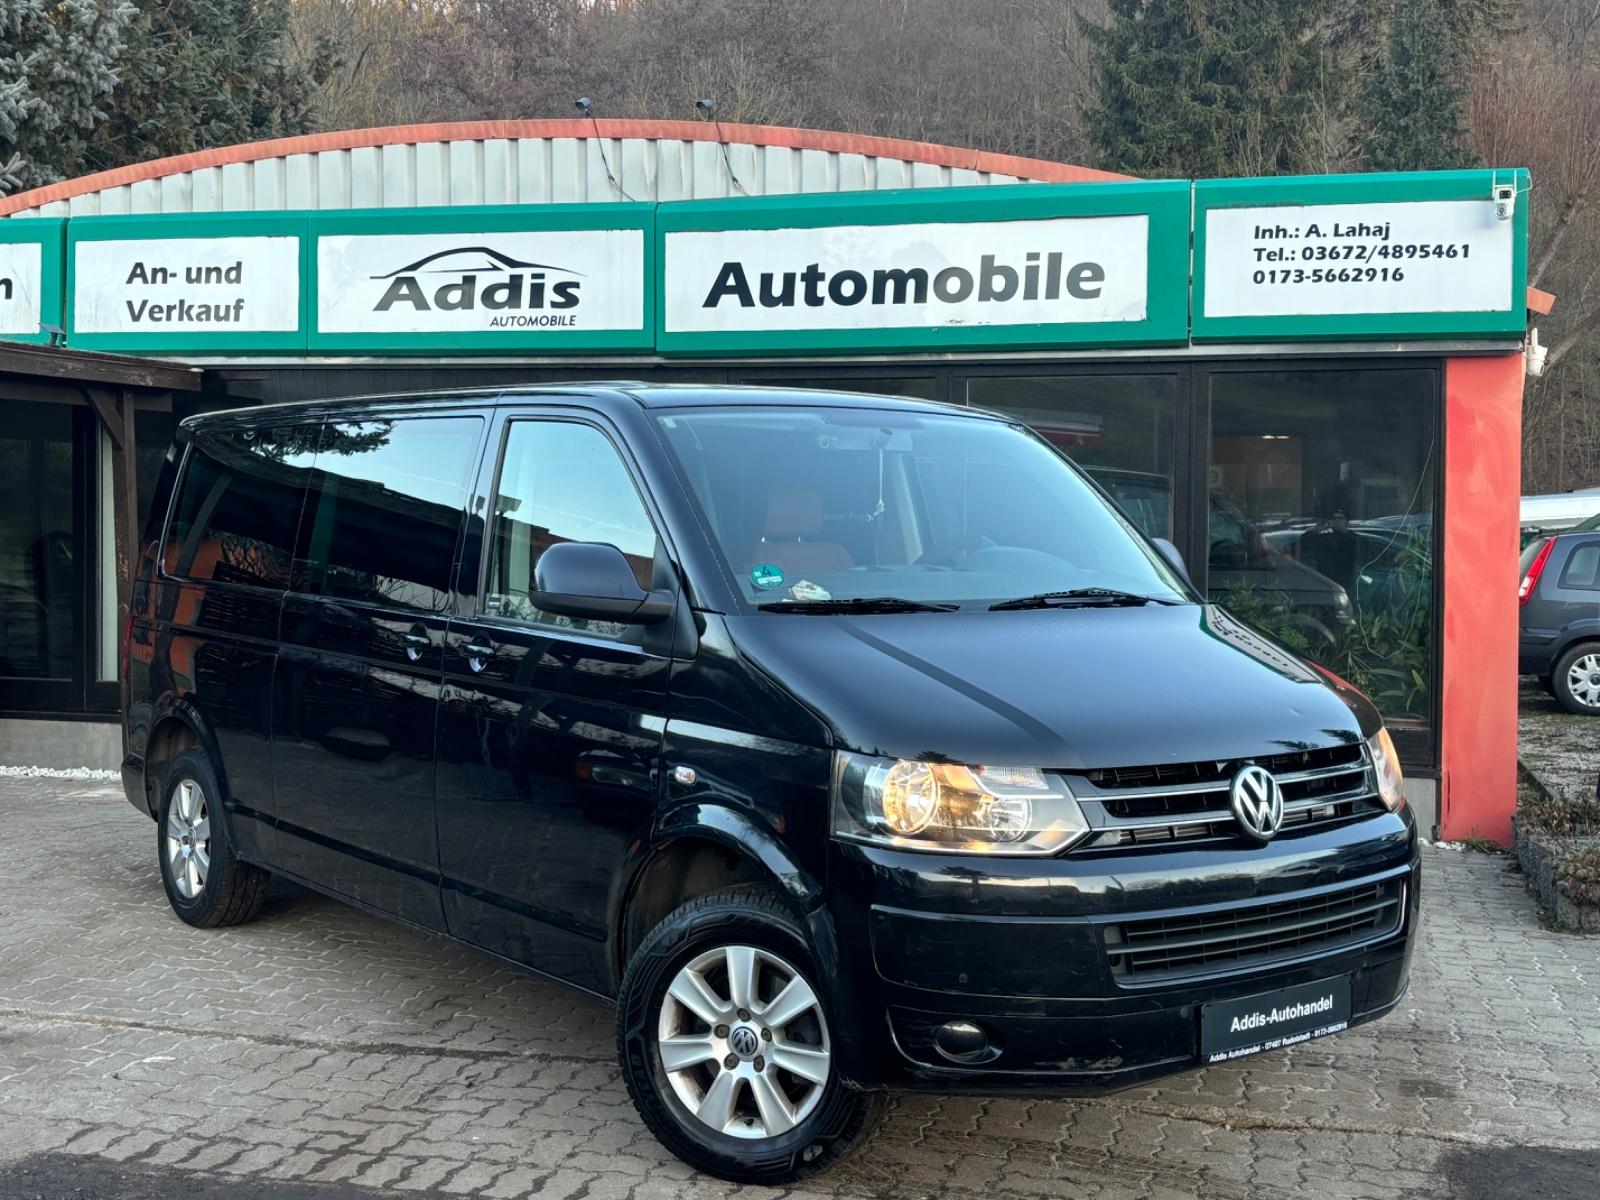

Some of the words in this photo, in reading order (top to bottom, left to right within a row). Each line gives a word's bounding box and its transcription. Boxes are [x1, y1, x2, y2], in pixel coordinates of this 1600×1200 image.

[1254, 224, 1300, 240] Inh.:
[1304, 223, 1327, 238] A.
[1333, 222, 1390, 241] Lahaj
[1253, 247, 1296, 262] Tel.:
[1301, 244, 1470, 263] 03672/4895461
[126, 262, 177, 285] An-
[185, 261, 243, 285] und
[702, 252, 1105, 308] Automobile
[1253, 267, 1405, 285] 0173-5662916
[373, 275, 581, 312] Addis
[126, 298, 245, 323] Verkauf
[490, 315, 577, 328] AUTOMOBILE
[1235, 766, 1283, 838] VW
[1230, 994, 1333, 1032] Addis-Autohandel
[1209, 1054, 1228, 1063] Addis
[1228, 1046, 1261, 1059] Autohandel
